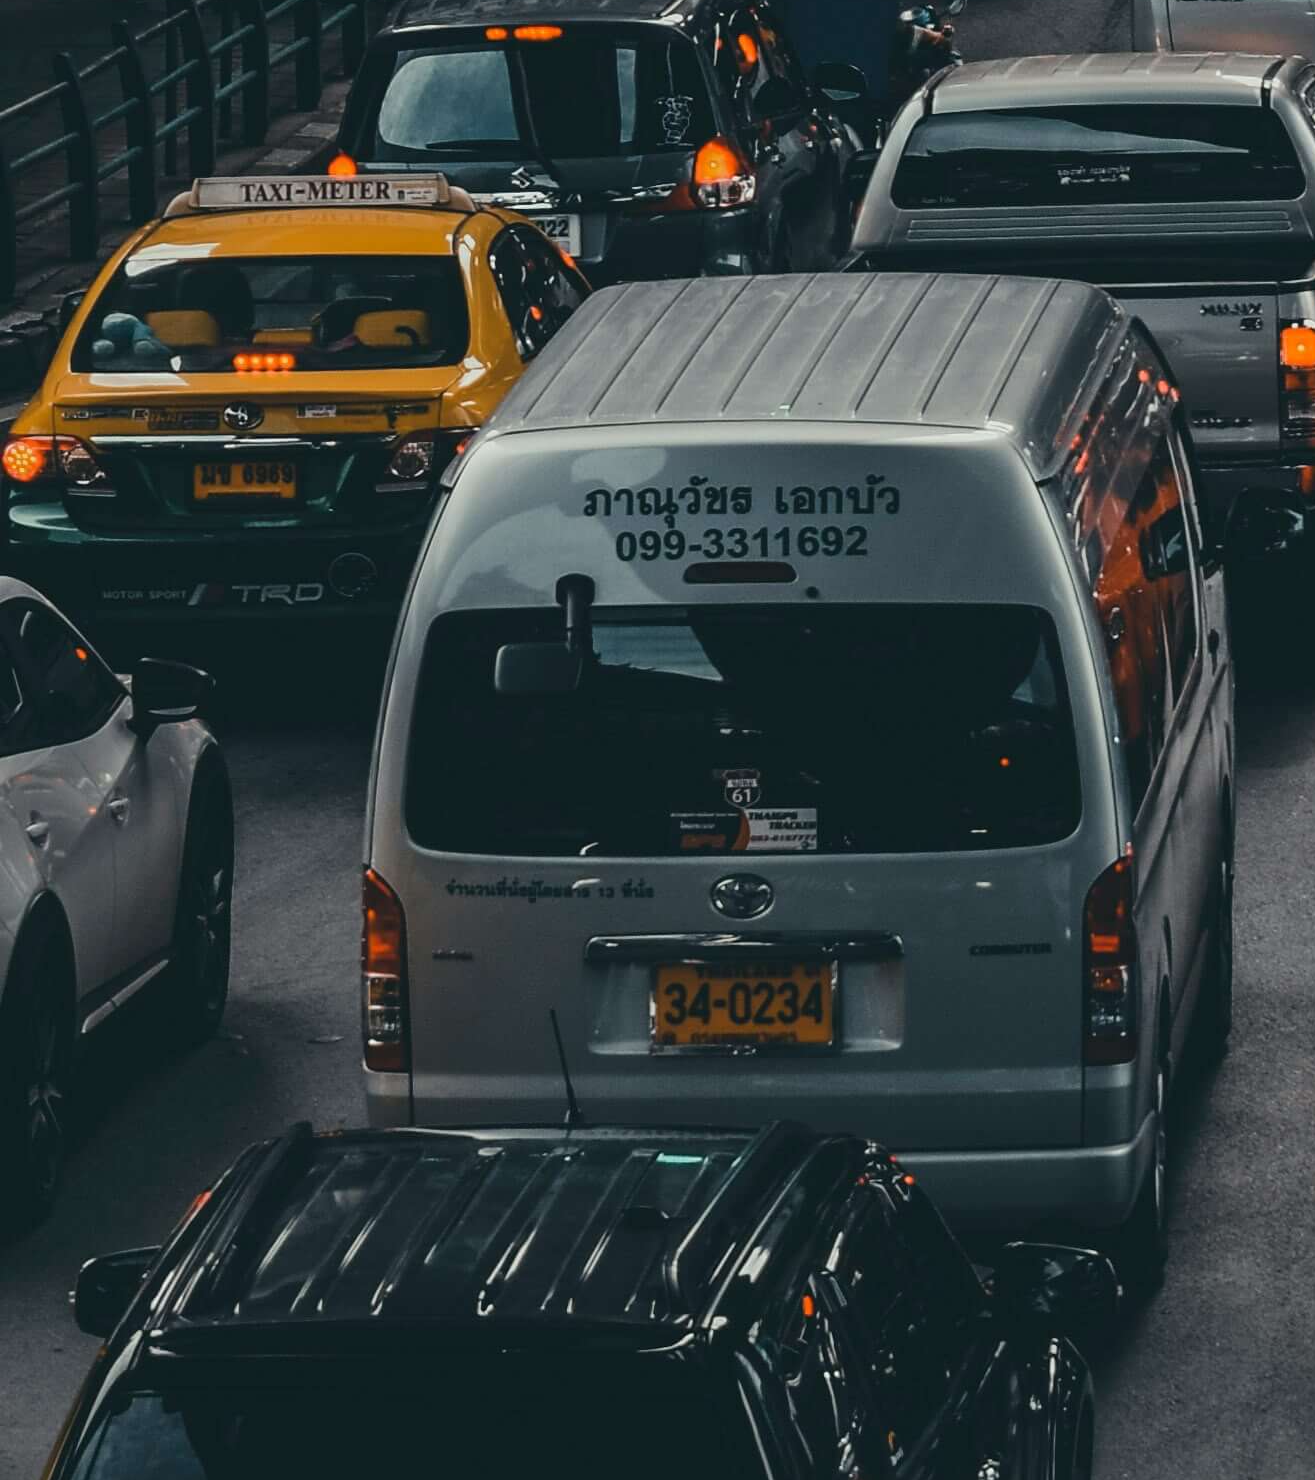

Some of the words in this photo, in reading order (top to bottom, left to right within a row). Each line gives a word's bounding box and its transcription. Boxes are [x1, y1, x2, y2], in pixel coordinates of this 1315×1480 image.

[240, 180, 392, 204] TAXI-METER
[775, 472, 901, 518] เอกบัว
[615, 524, 868, 562] 099-3311692
[103, 588, 145, 601] MOTOR
[231, 582, 324, 606] TRD
[732, 788, 752, 803] 61
[665, 981, 823, 1026] 34-0234
